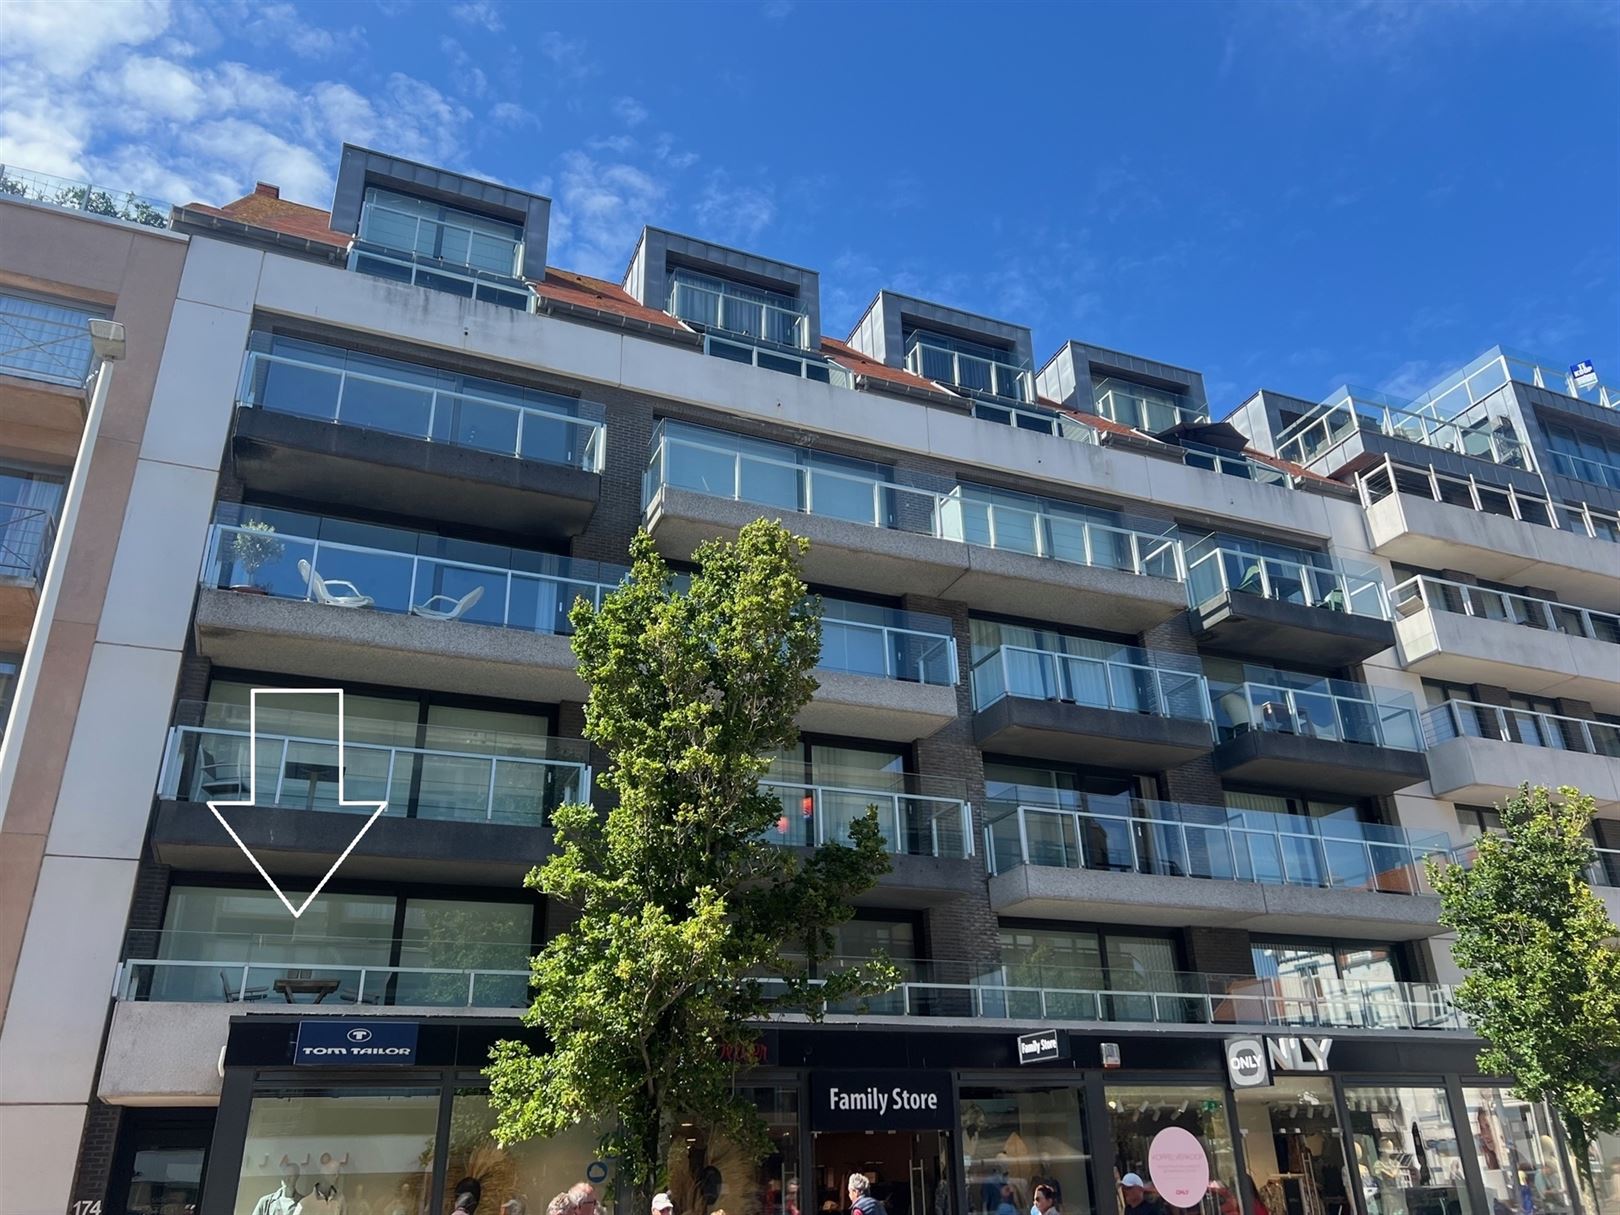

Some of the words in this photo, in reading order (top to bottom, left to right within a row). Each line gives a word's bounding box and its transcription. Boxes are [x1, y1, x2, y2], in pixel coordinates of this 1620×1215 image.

[302, 1047, 347, 1055] TOM
[350, 1047, 411, 1055] TAILOR
[1021, 1040, 1040, 1054] Family
[1040, 1039, 1057, 1050] Store
[1230, 1054, 1262, 1070] ONLY
[830, 1087, 888, 1115] Family
[892, 1087, 938, 1109] Store
[72, 1200, 102, 1215] 174
